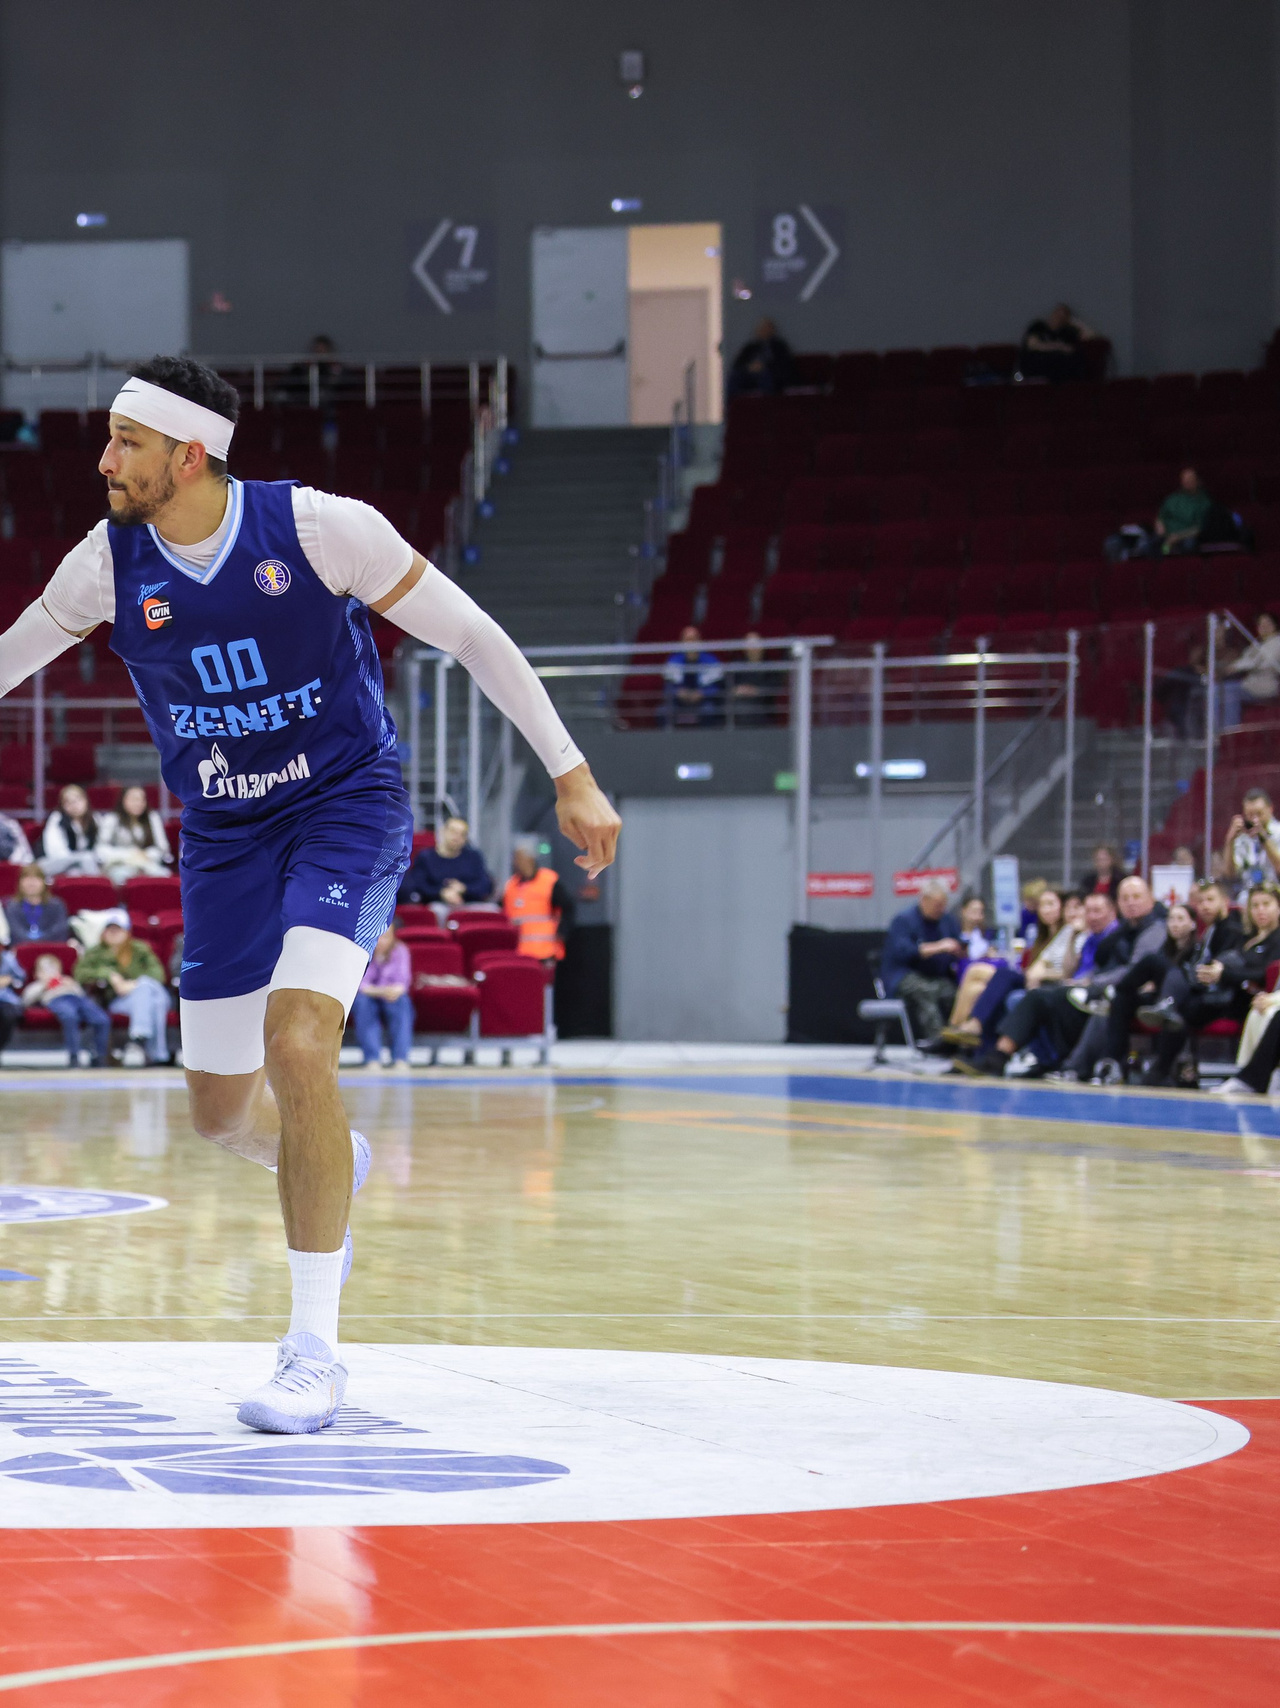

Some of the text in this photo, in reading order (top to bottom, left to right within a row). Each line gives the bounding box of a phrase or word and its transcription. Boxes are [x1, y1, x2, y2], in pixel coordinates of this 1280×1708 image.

[454, 225, 479, 269] 7
[772, 213, 798, 258] 8
[151, 605, 171, 619] WIN
[191, 637, 269, 694] 00
[168, 677, 322, 739] ZENIT
[318, 896, 350, 909] KELME
